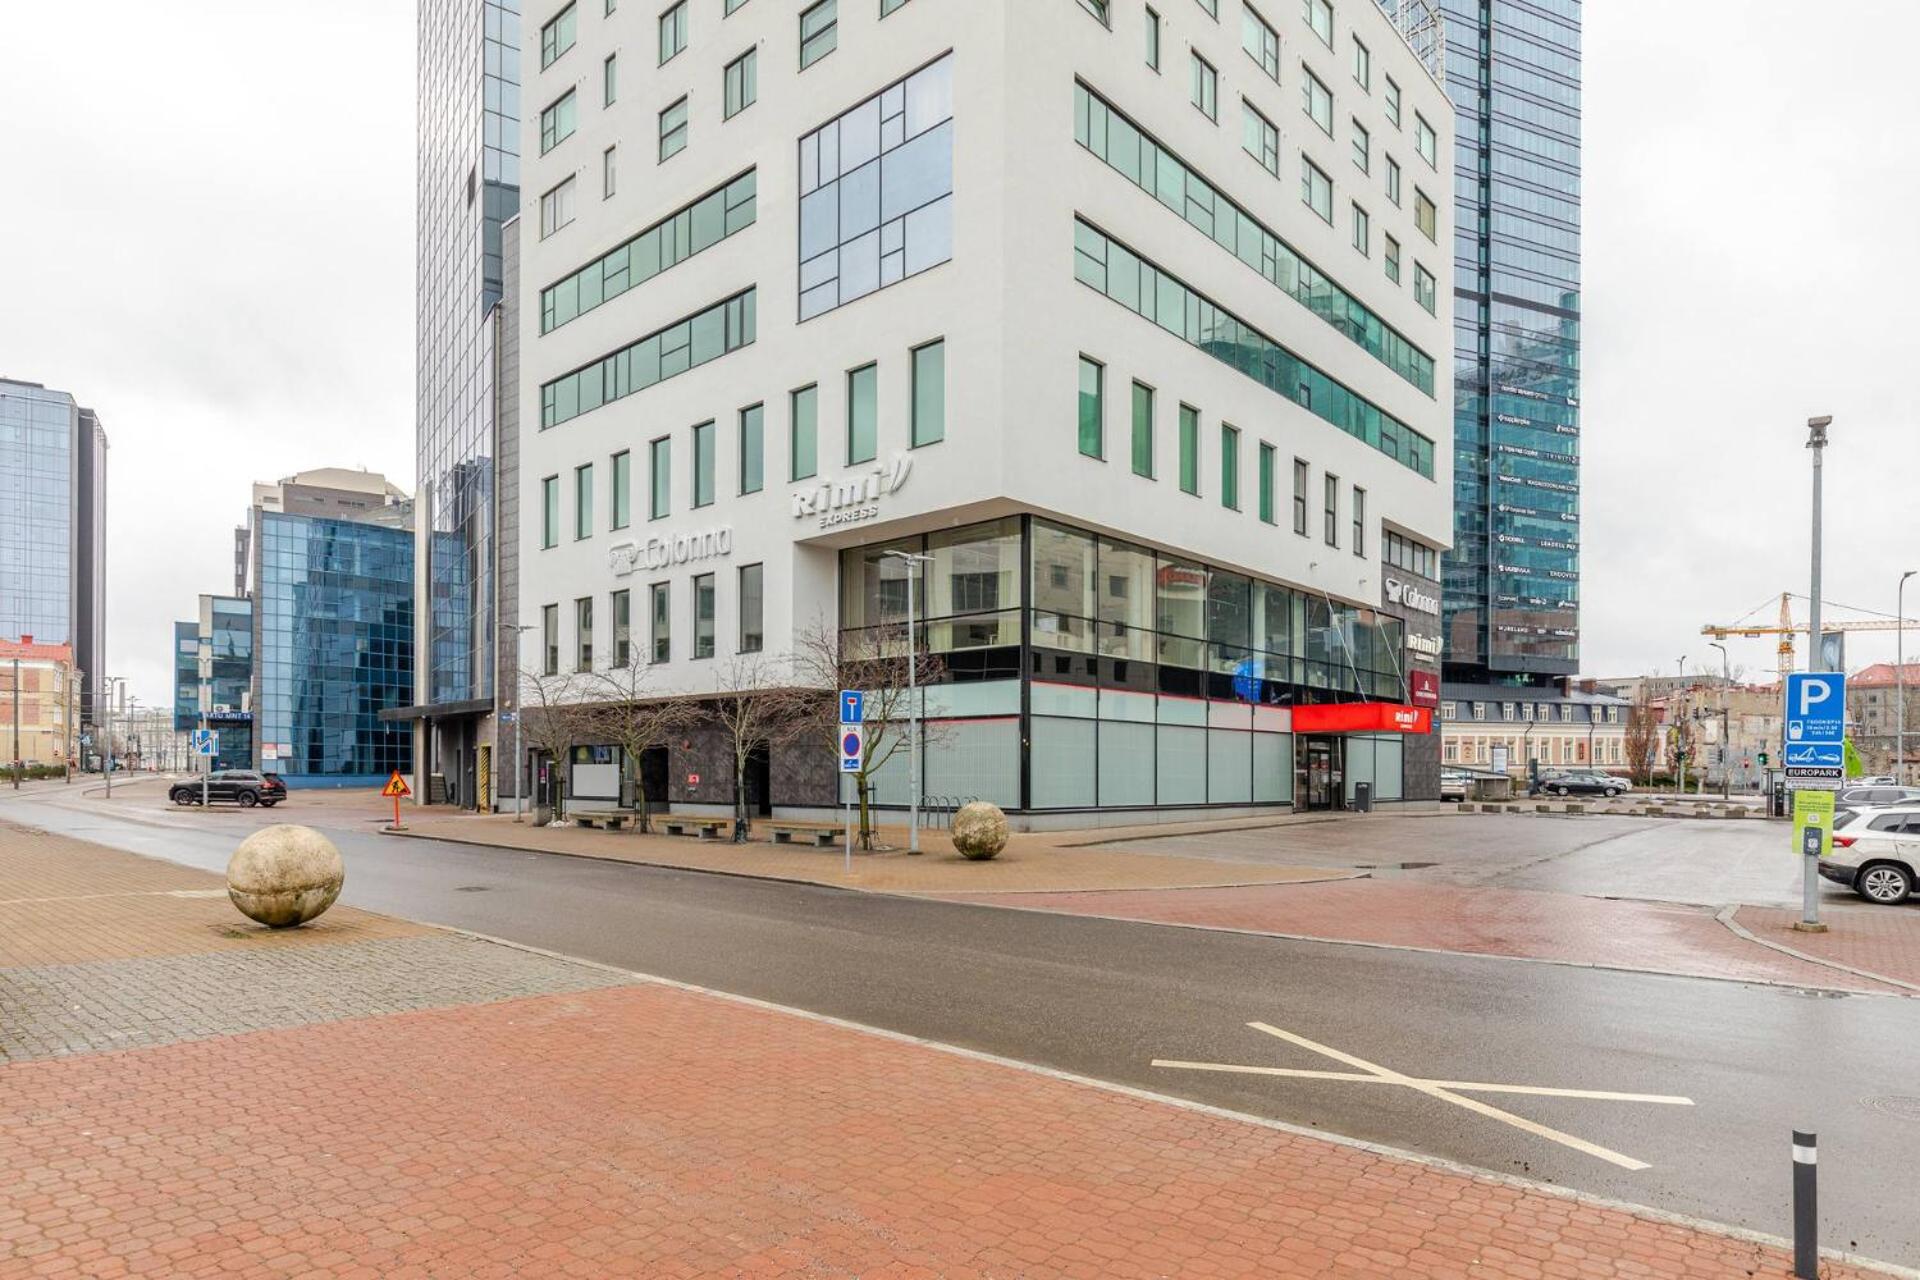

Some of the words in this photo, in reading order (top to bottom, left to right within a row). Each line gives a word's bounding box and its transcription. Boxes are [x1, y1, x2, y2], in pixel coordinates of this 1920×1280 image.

[791, 464, 882, 519] Rimi
[818, 505, 880, 530] EXPRESS
[646, 527, 734, 572] Colonna
[1407, 632, 1437, 655] Rimi
[1800, 679, 1832, 716] P
[1787, 768, 1839, 778] EUROPARK
